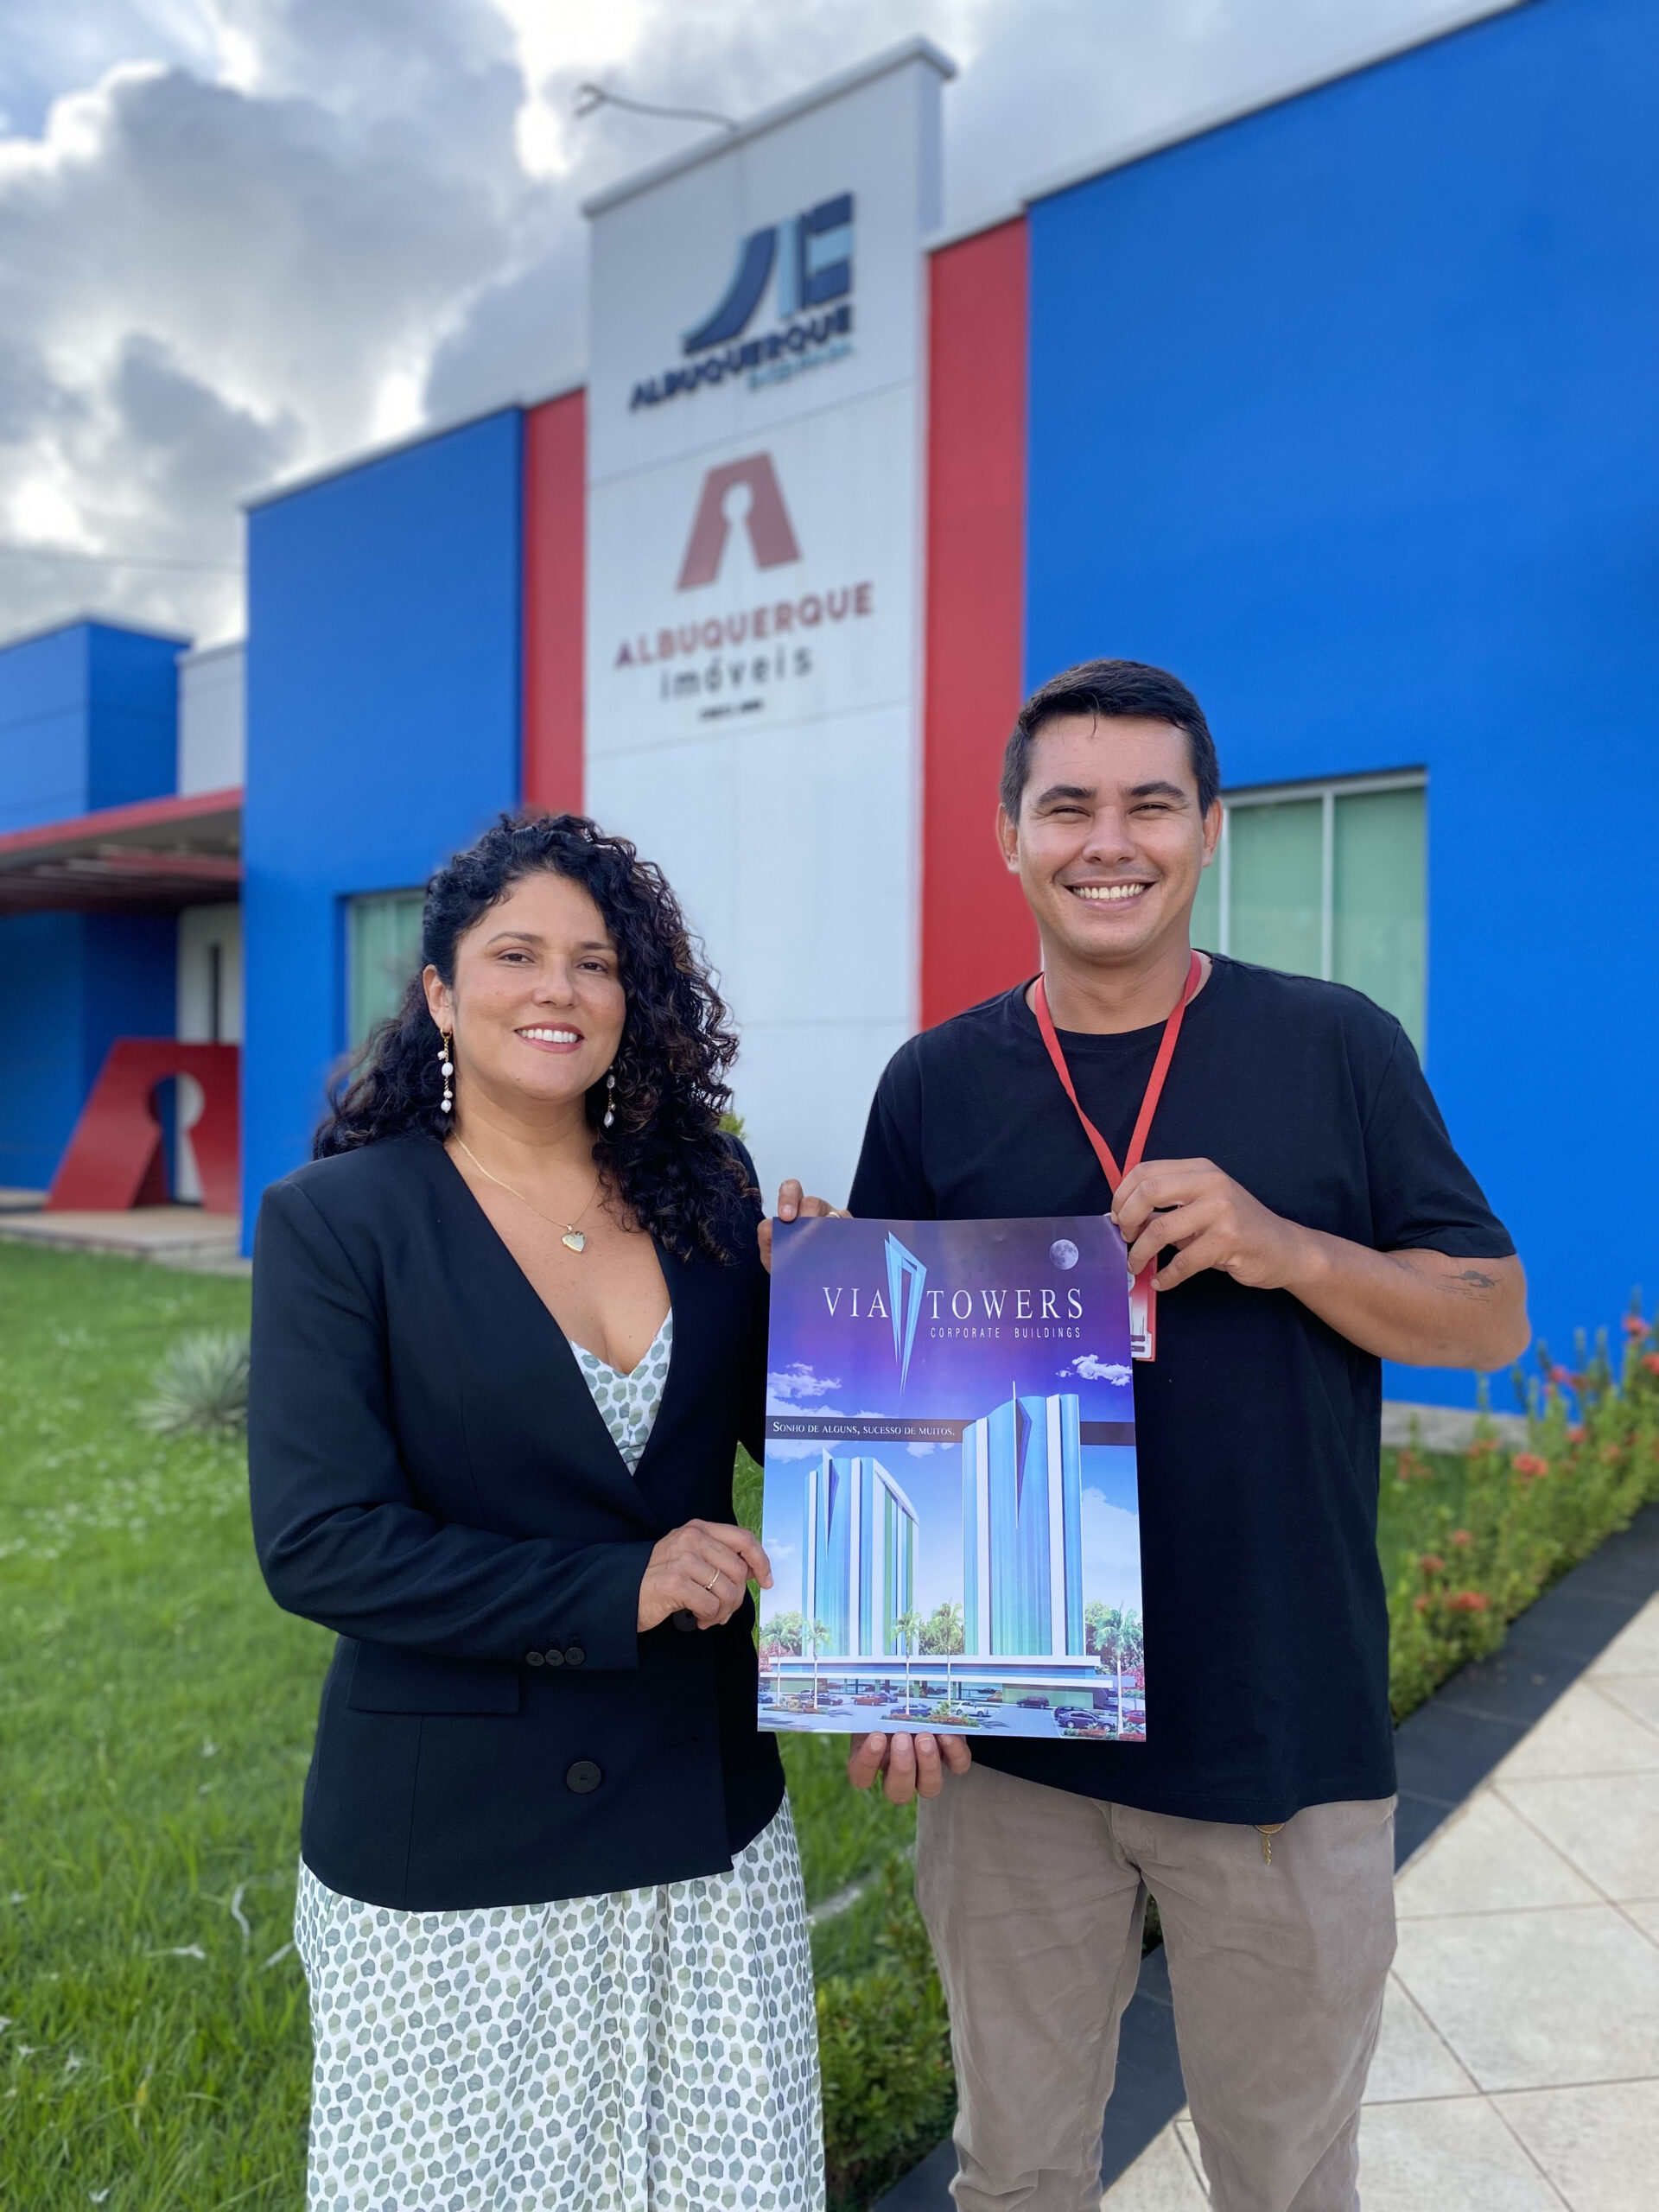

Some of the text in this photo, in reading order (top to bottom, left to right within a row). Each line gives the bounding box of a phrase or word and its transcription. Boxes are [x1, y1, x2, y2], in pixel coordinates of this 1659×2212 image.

[613, 579, 874, 671] ALBUQUERQUE
[659, 644, 814, 701] imóveis
[822, 1287, 1084, 1320] VIA TOWERS
[930, 1325, 1081, 1339] CORPORATE BUILDINGS
